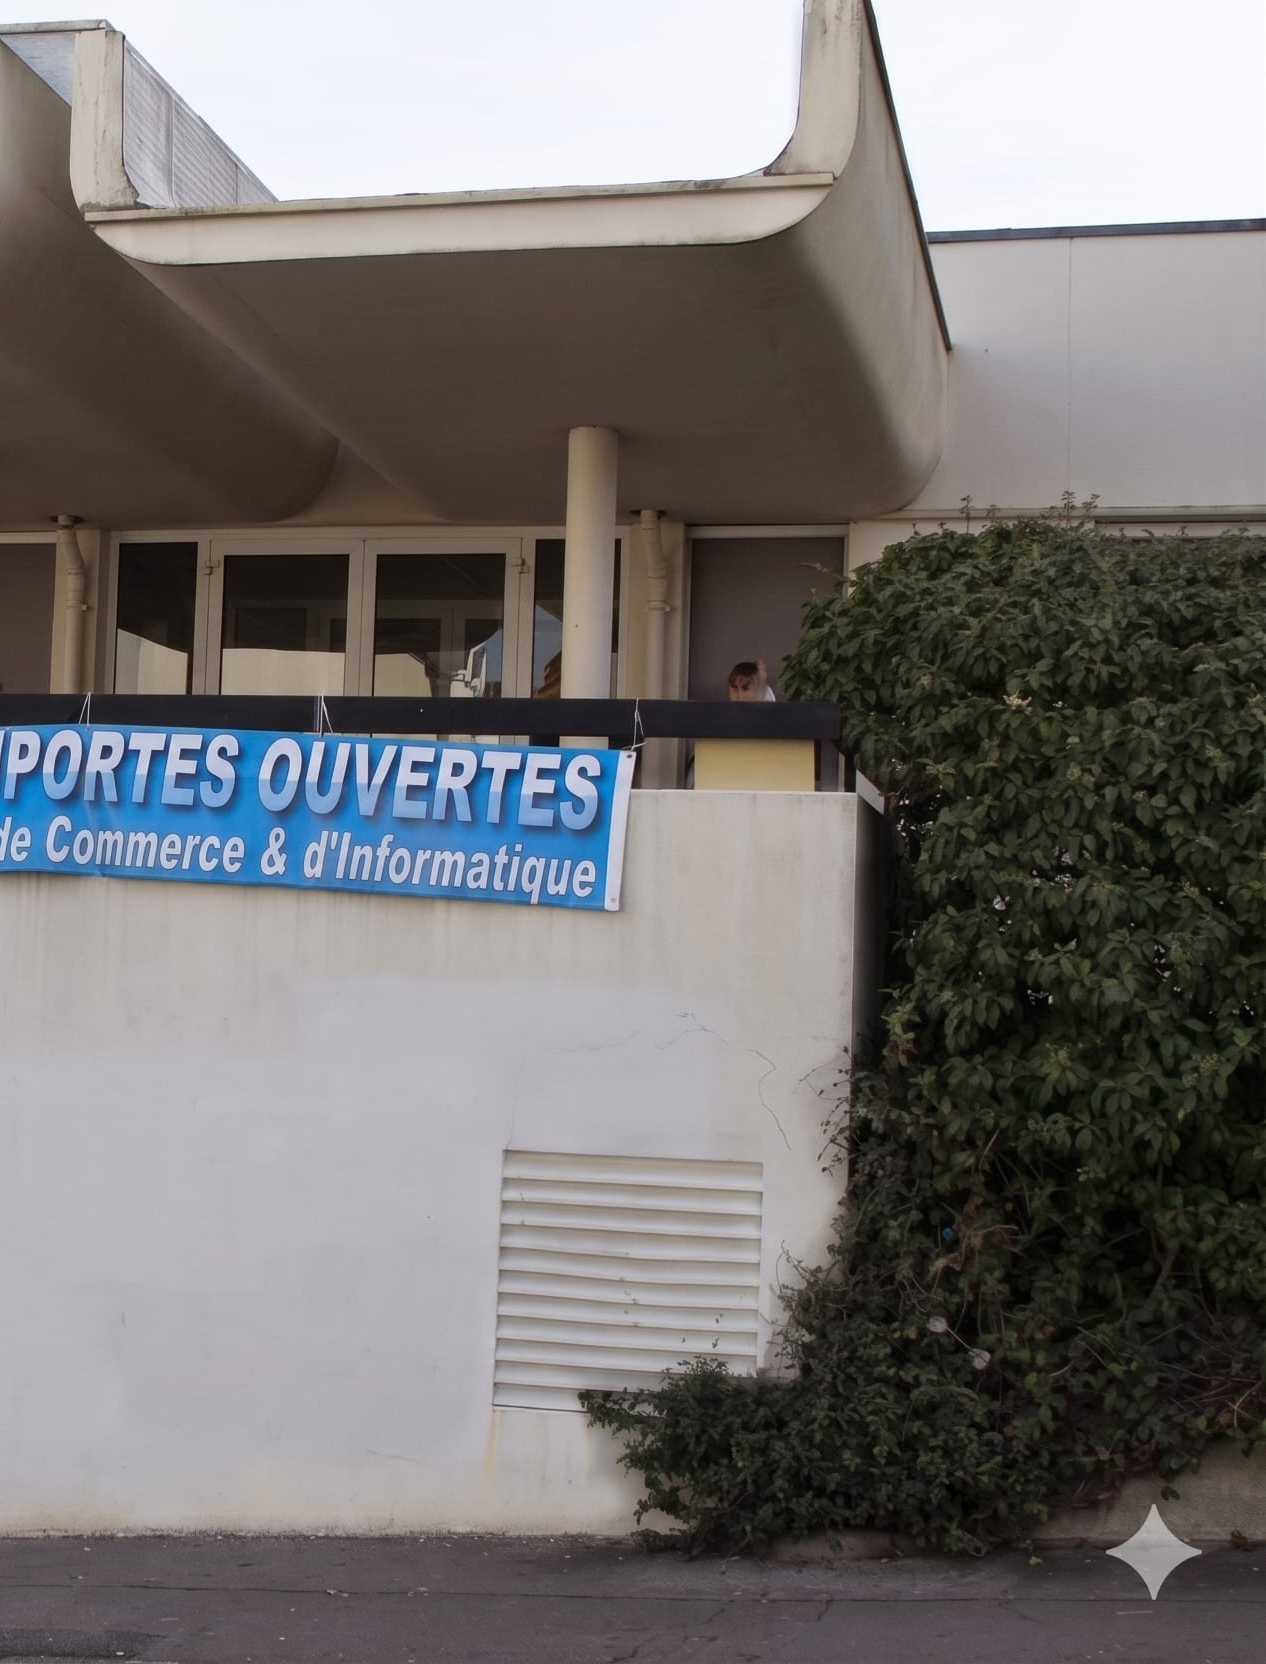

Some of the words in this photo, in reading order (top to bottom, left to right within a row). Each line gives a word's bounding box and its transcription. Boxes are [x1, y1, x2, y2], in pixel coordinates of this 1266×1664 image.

[3, 730, 239, 808] PORTES
[257, 737, 601, 831] OUVERTES
[45, 815, 246, 873] Commerce
[260, 826, 287, 876] &
[303, 830, 597, 905] d'Informatique
